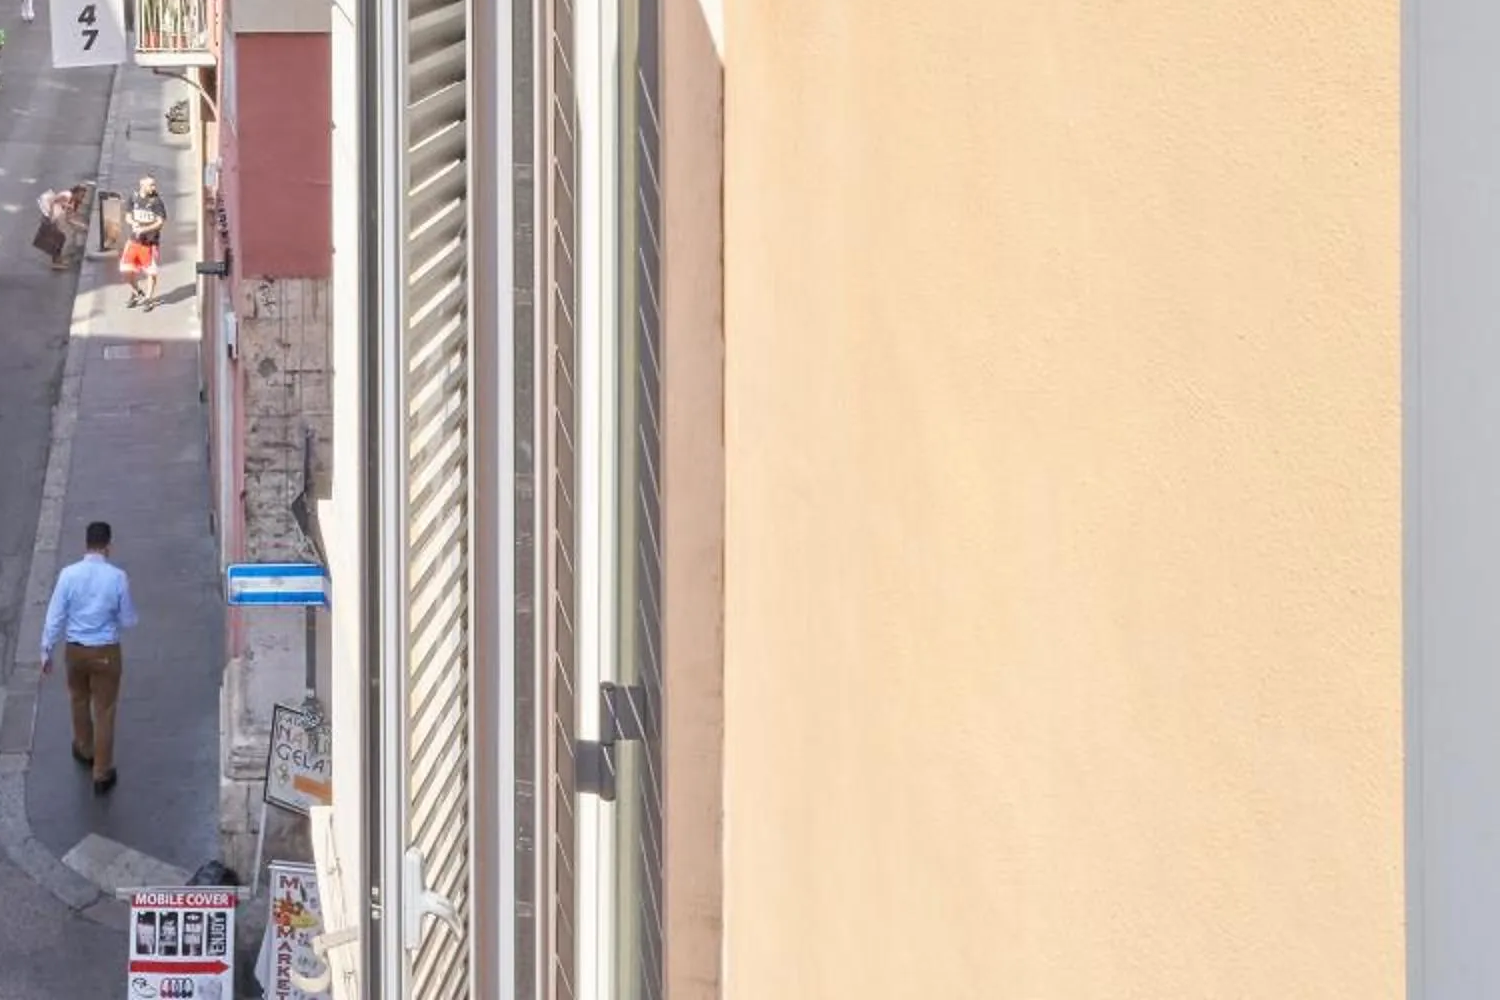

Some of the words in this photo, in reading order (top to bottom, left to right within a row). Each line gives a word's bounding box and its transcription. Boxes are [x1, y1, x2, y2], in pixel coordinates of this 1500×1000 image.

[77, 3, 99, 51] 47
[135, 892, 184, 906] MOBILE
[185, 892, 230, 907] COVER
